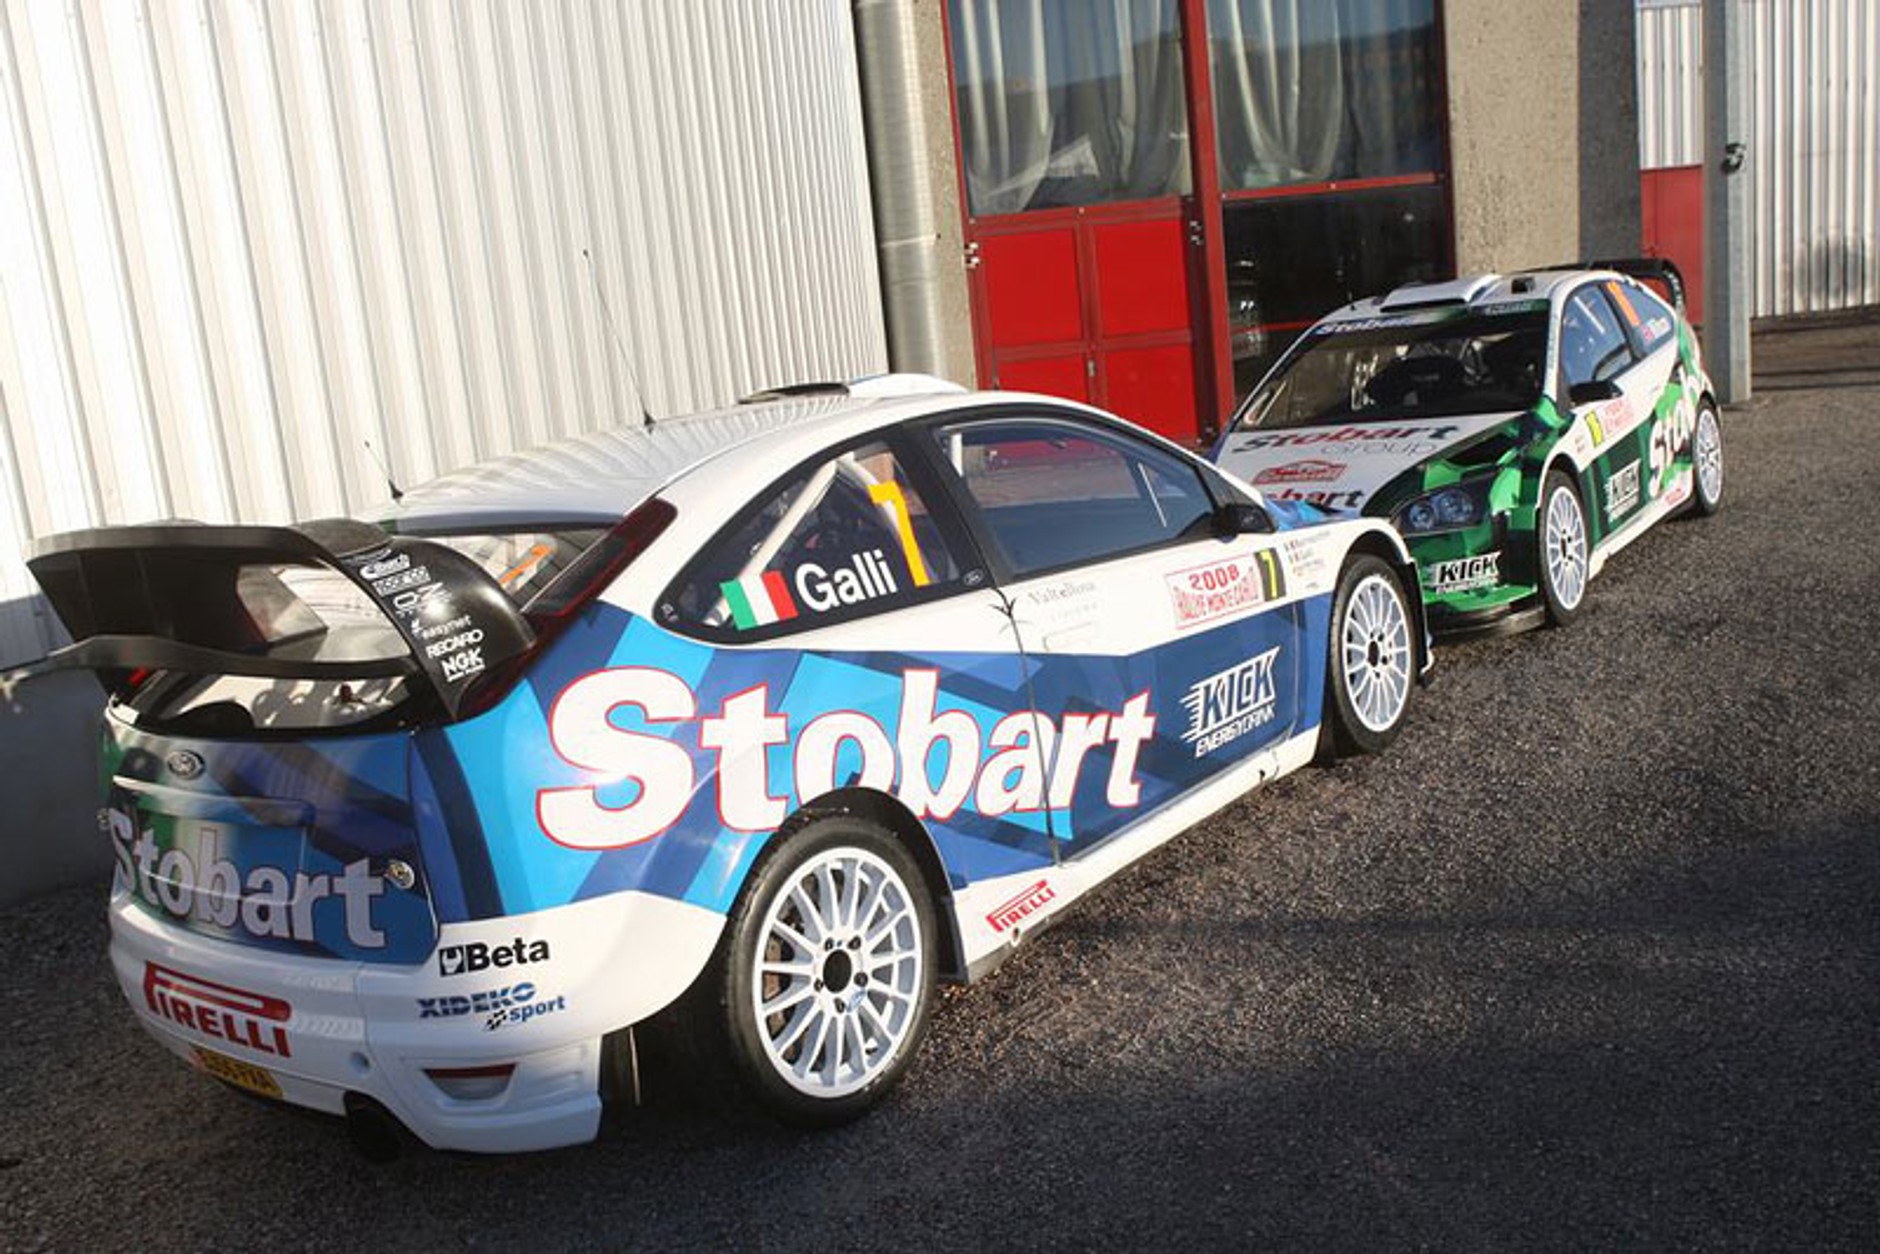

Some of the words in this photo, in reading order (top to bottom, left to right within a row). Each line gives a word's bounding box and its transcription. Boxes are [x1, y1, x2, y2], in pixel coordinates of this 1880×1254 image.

[1233, 426, 1459, 453] Stobart
[795, 549, 897, 612] Galli
[1188, 564, 1239, 591] 2008
[426, 629, 484, 658] RECARO
[441, 648, 484, 677] NGK
[1198, 652, 1277, 735] KICK
[536, 667, 1154, 850] Stobart
[108, 807, 386, 948] Stobart
[985, 879, 1055, 932] PIRELLI
[466, 937, 551, 973] Beta
[144, 960, 292, 1058] PIRELLI
[417, 982, 536, 1018] XIDEKO
[510, 996, 566, 1022] sport
